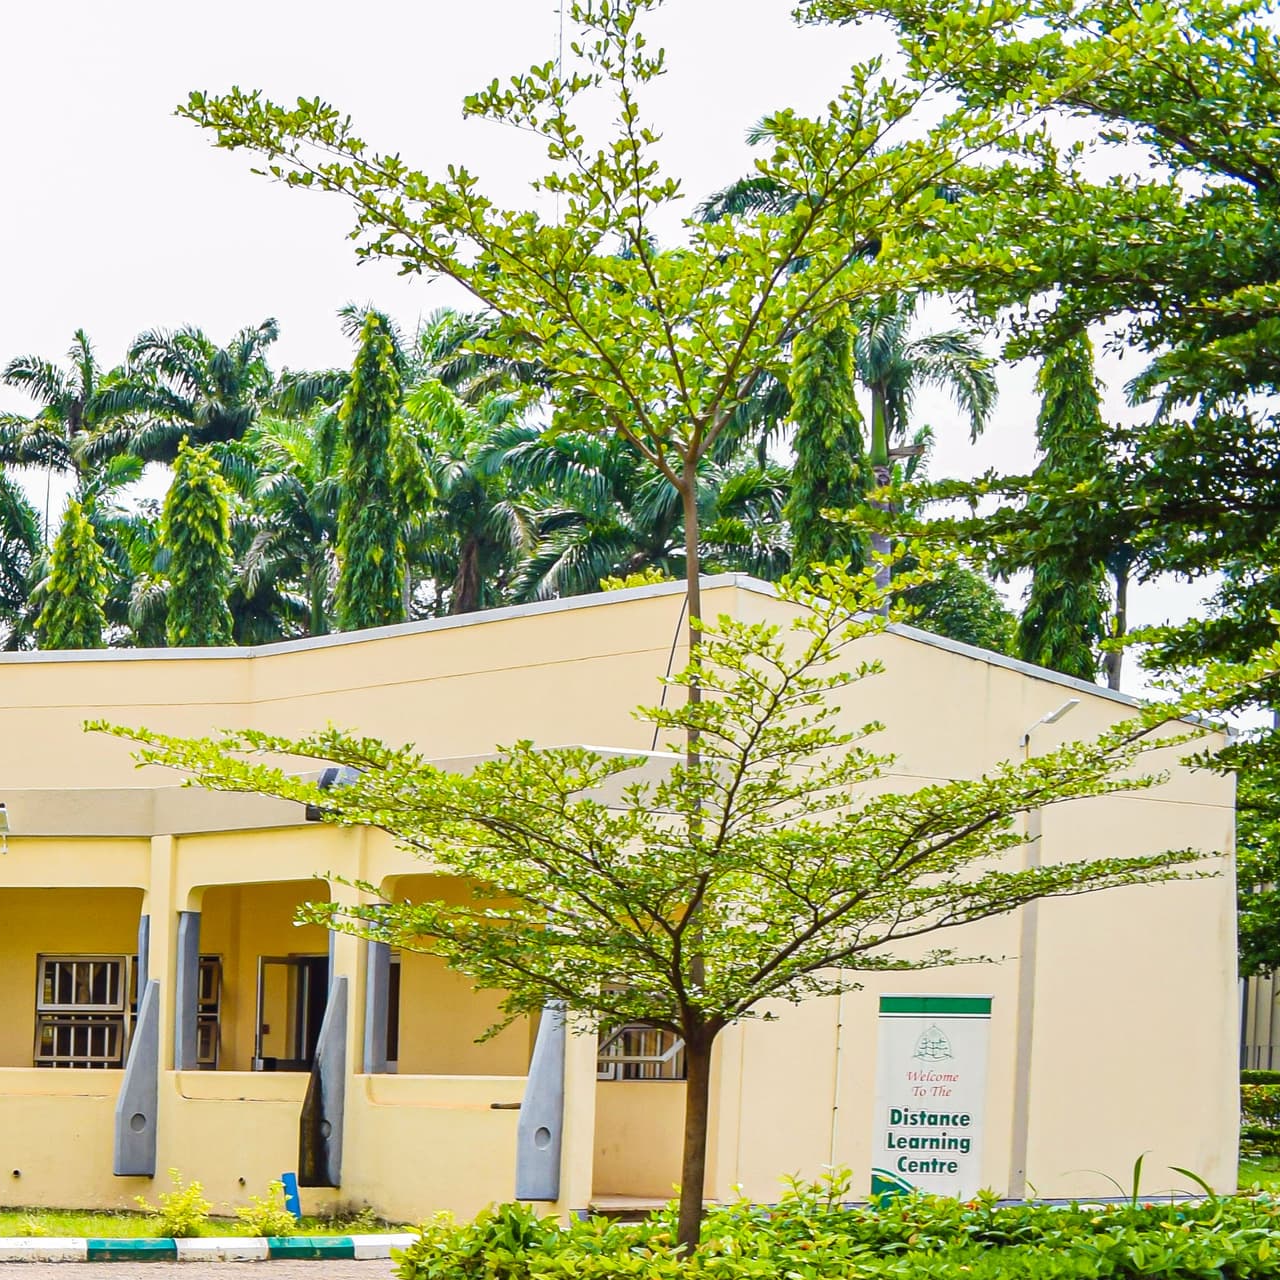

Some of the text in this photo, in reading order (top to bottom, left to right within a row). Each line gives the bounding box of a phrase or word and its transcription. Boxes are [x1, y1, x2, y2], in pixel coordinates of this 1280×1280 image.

[906, 1070, 959, 1082] Welcome
[912, 1085, 952, 1097] To The
[890, 1107, 970, 1126] Distance
[887, 1132, 971, 1154] Learning
[897, 1156, 958, 1173] Centre
